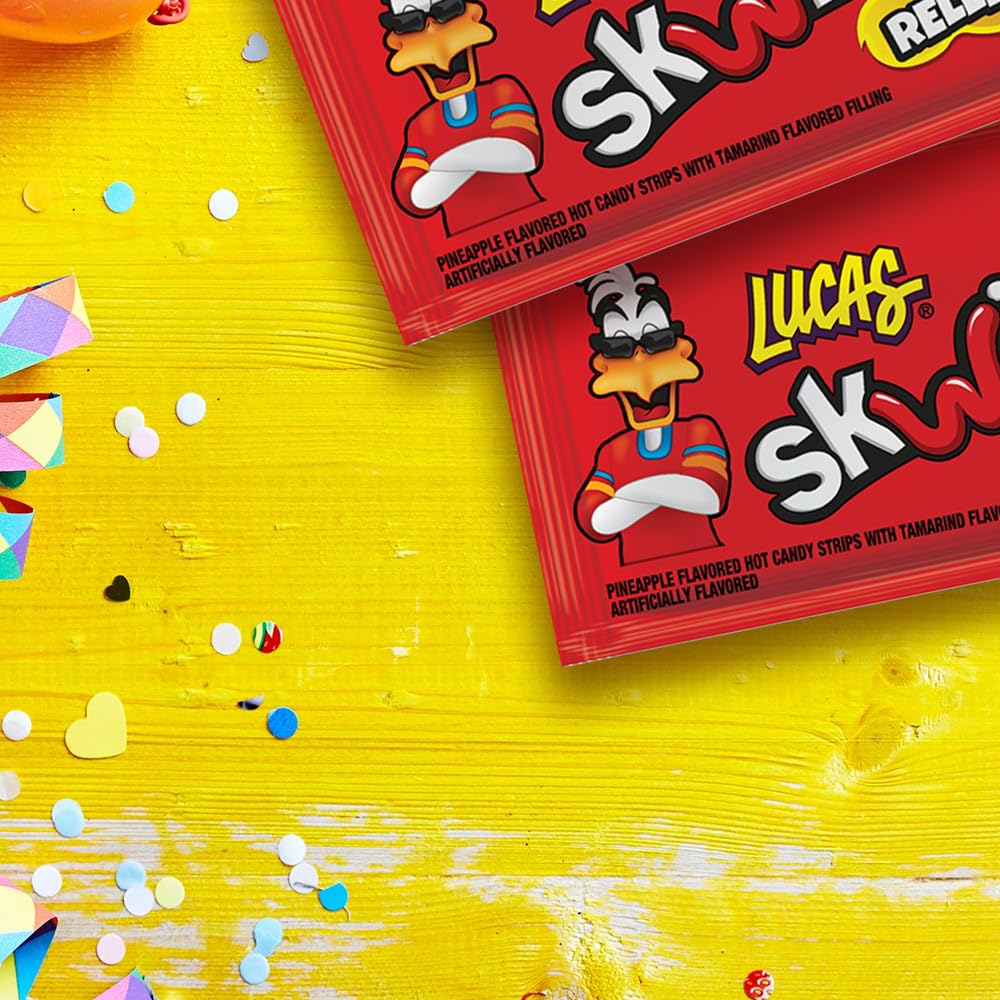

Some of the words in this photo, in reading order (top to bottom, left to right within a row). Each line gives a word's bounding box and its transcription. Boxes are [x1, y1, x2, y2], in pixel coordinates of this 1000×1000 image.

[436, 234, 504, 272] PINEAPPLE
[503, 210, 567, 247] FLAVORED
[567, 199, 593, 221] HOT
[596, 183, 636, 211] CANDY
[640, 166, 683, 195] STRIPS
[682, 154, 716, 178] WITH
[715, 129, 781, 165] TAMARIND
[781, 104, 844, 140] FLAVORED
[845, 86, 893, 116] FILLING
[443, 249, 523, 289] ARTIFICIALLY
[525, 223, 587, 259] FLAVORED
[750, 247, 924, 364] LUCAS
[606, 571, 675, 599] PINEAPPLE
[677, 558, 741, 585] FLAVORED
[744, 552, 768, 572] HOT
[772, 543, 814, 565] CANDY
[817, 533, 862, 557] STRIPS
[864, 526, 897, 547] WITH
[898, 512, 965, 540] TAMARIND
[611, 587, 691, 617] ARTIFICIALLY
[695, 573, 759, 600] FLAVORED
